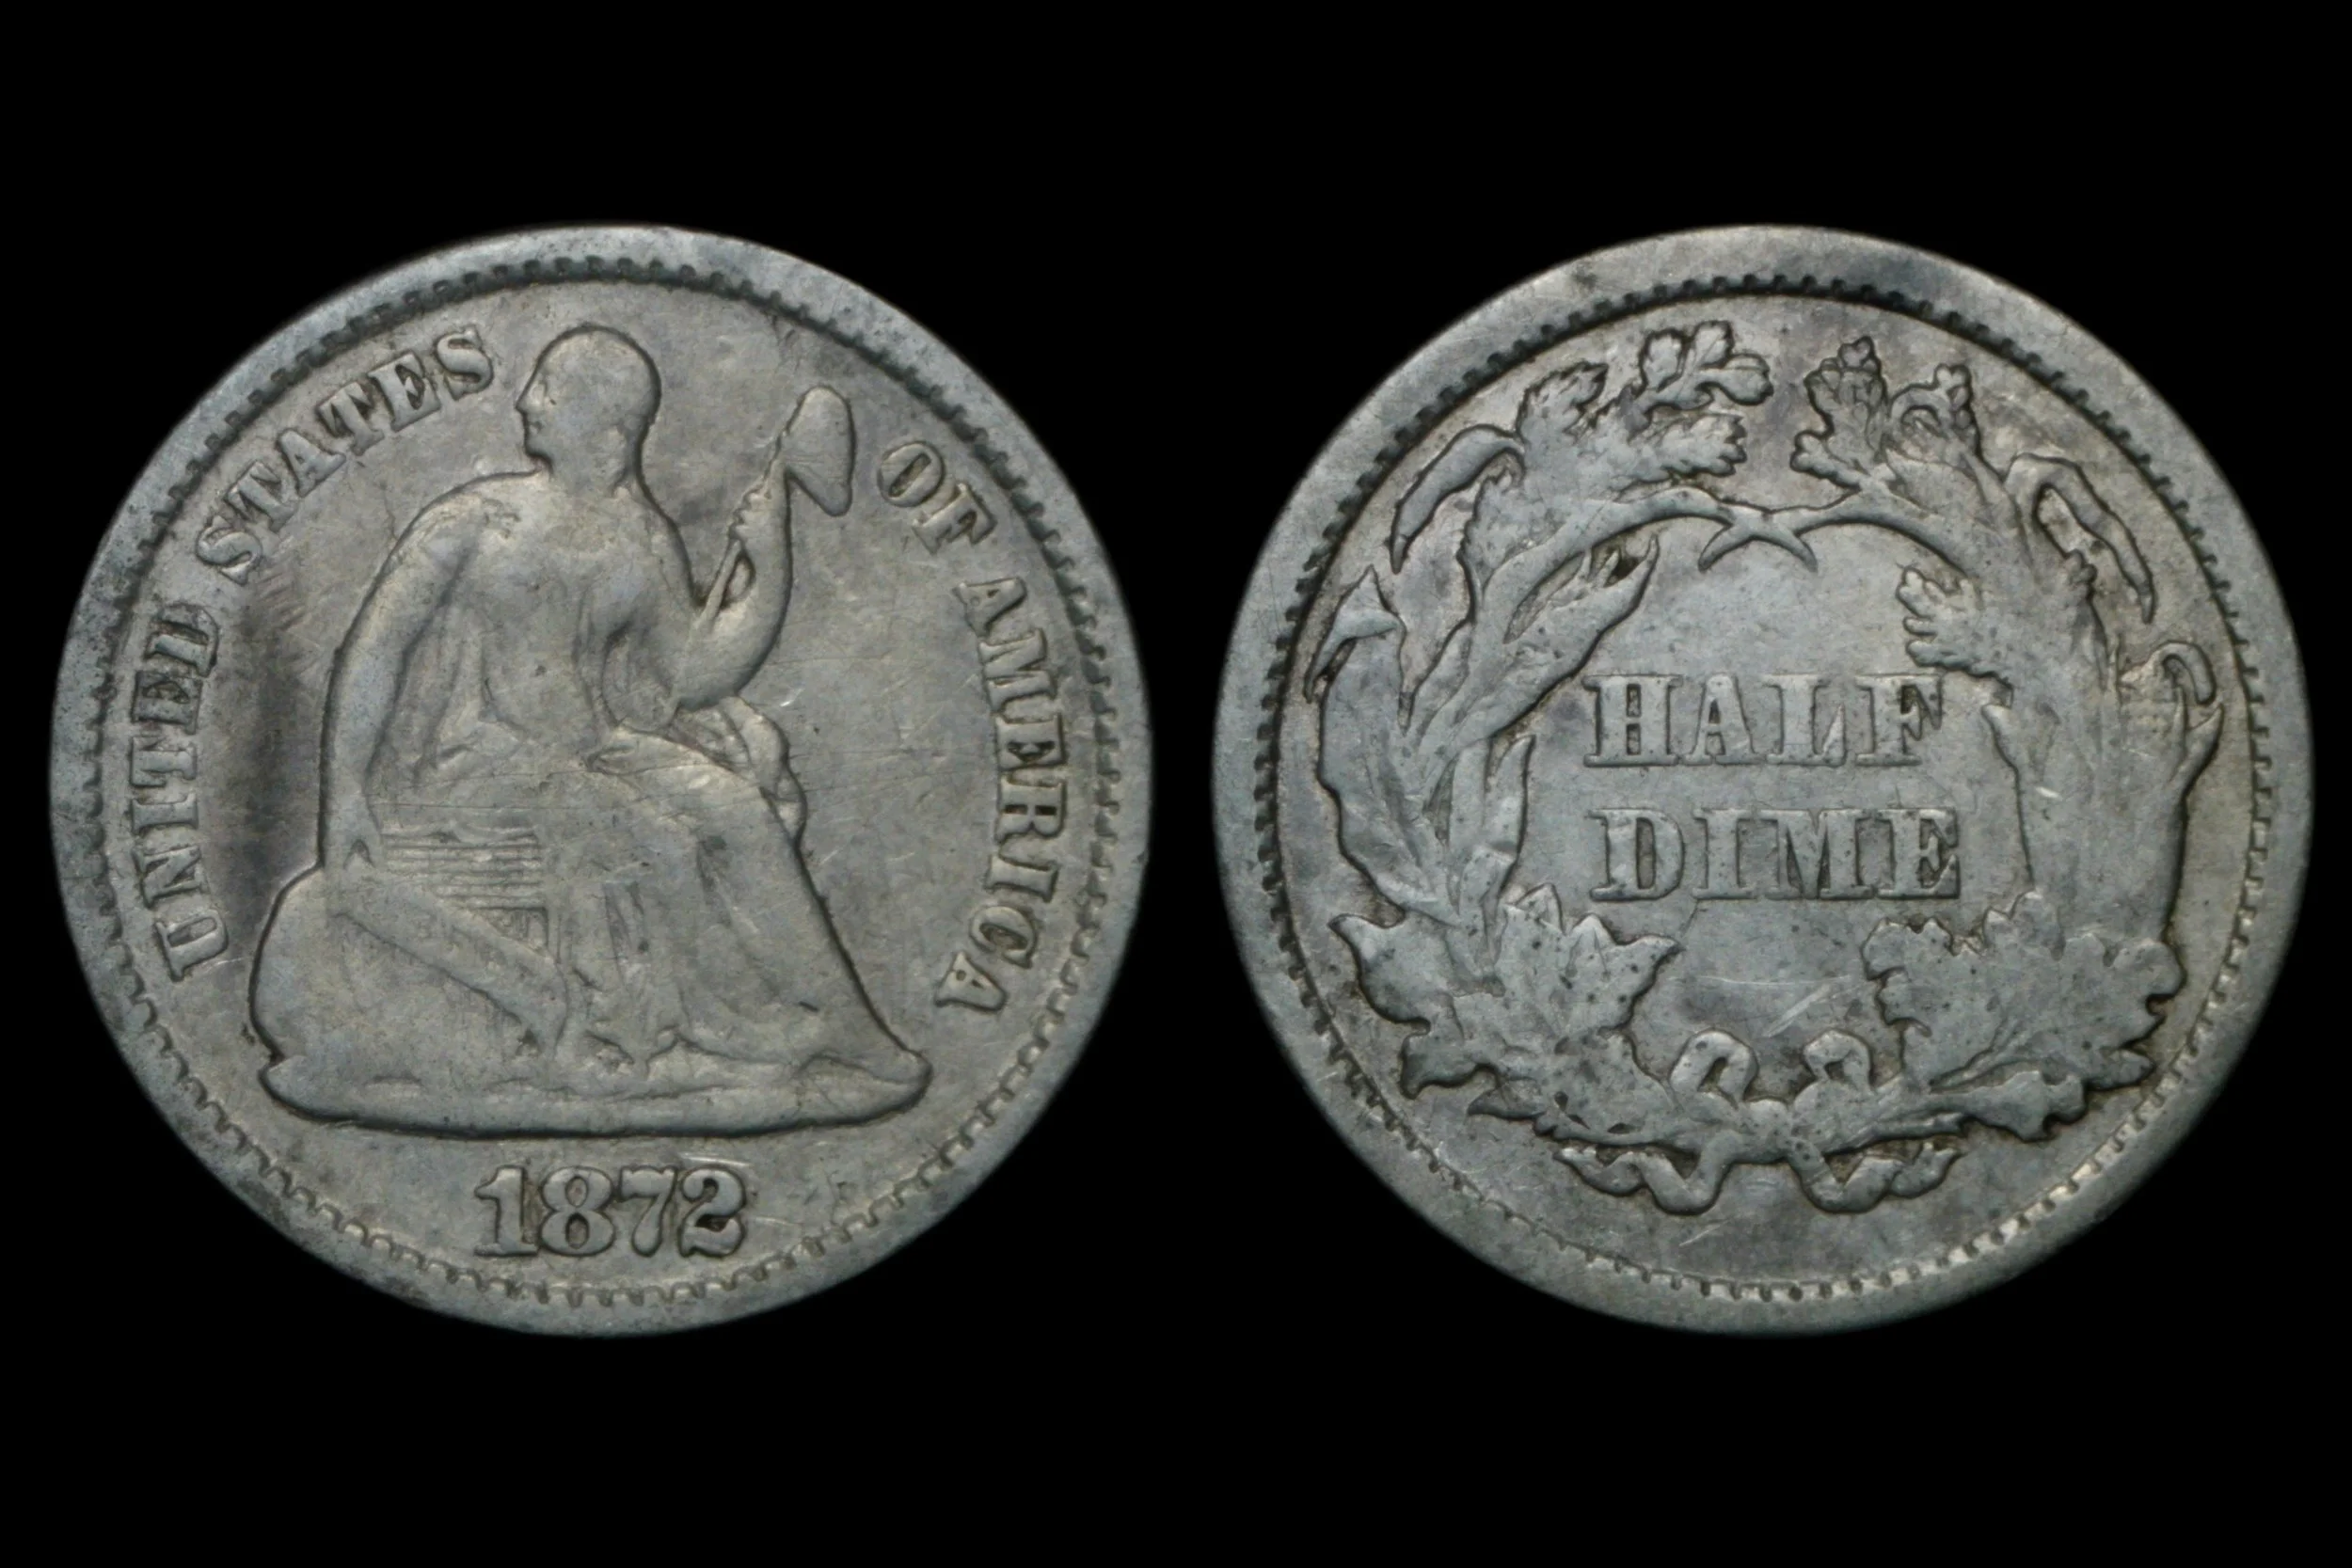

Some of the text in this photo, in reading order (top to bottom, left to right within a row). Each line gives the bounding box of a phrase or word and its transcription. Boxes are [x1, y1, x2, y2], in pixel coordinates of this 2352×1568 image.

[130, 327, 1068, 1012] UNITED STATES OF AMERICA
[1582, 672, 1944, 768] HALF
[1588, 806, 1962, 901] DIME
[473, 1164, 748, 1258] 1872
